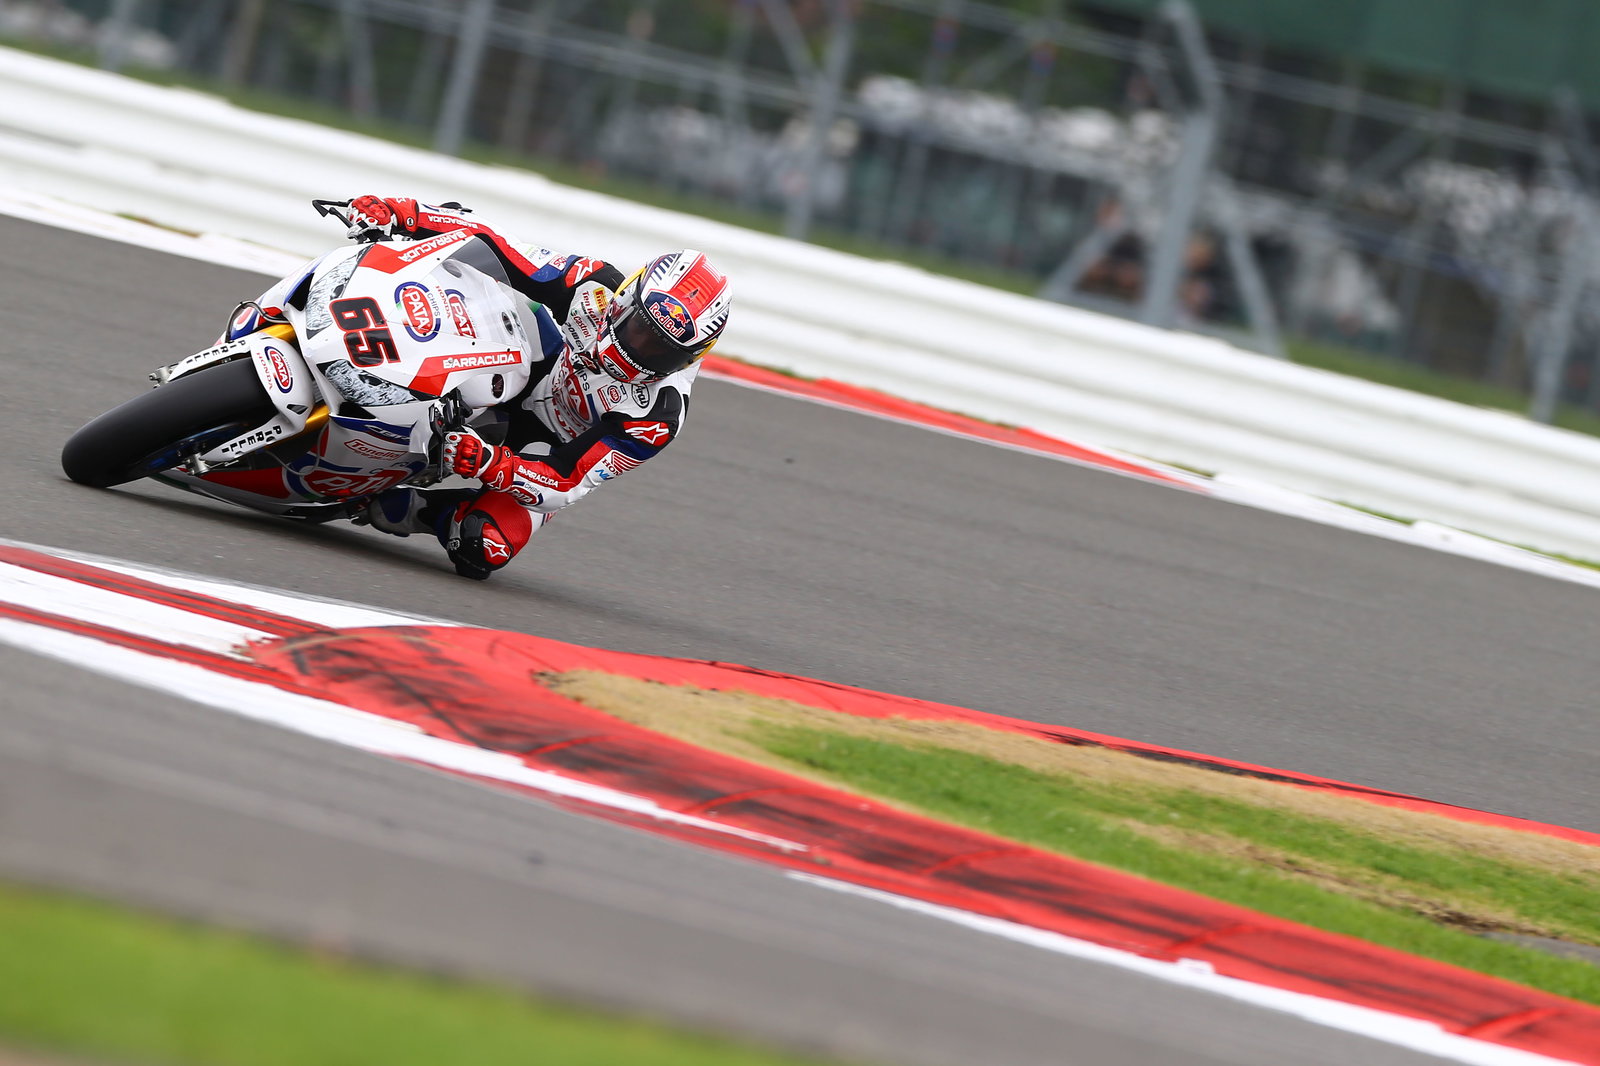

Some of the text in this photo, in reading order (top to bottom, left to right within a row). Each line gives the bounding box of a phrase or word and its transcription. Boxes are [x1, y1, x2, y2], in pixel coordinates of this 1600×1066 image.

[427, 214, 479, 229] BARRACUDA
[398, 230, 468, 263] BARRACUDA
[404, 290, 433, 332] PATA
[427, 292, 441, 317] CHIPS
[435, 286, 451, 318] HONDA
[581, 290, 592, 307] Ten
[329, 296, 402, 368] 65
[573, 314, 592, 338] Castrol
[648, 302, 686, 339] Red Bull
[186, 339, 247, 364] PIRELLI
[443, 353, 515, 369] BARRACUDA
[609, 324, 656, 376] www.jonathan-rea.com
[256, 352, 273, 390] HONDA
[270, 352, 290, 384] PATA
[633, 384, 651, 405] Arai
[221, 425, 283, 454] PIRELLI
[517, 464, 559, 488] BARRACUDA
[524, 482, 541, 496] CHIPS
